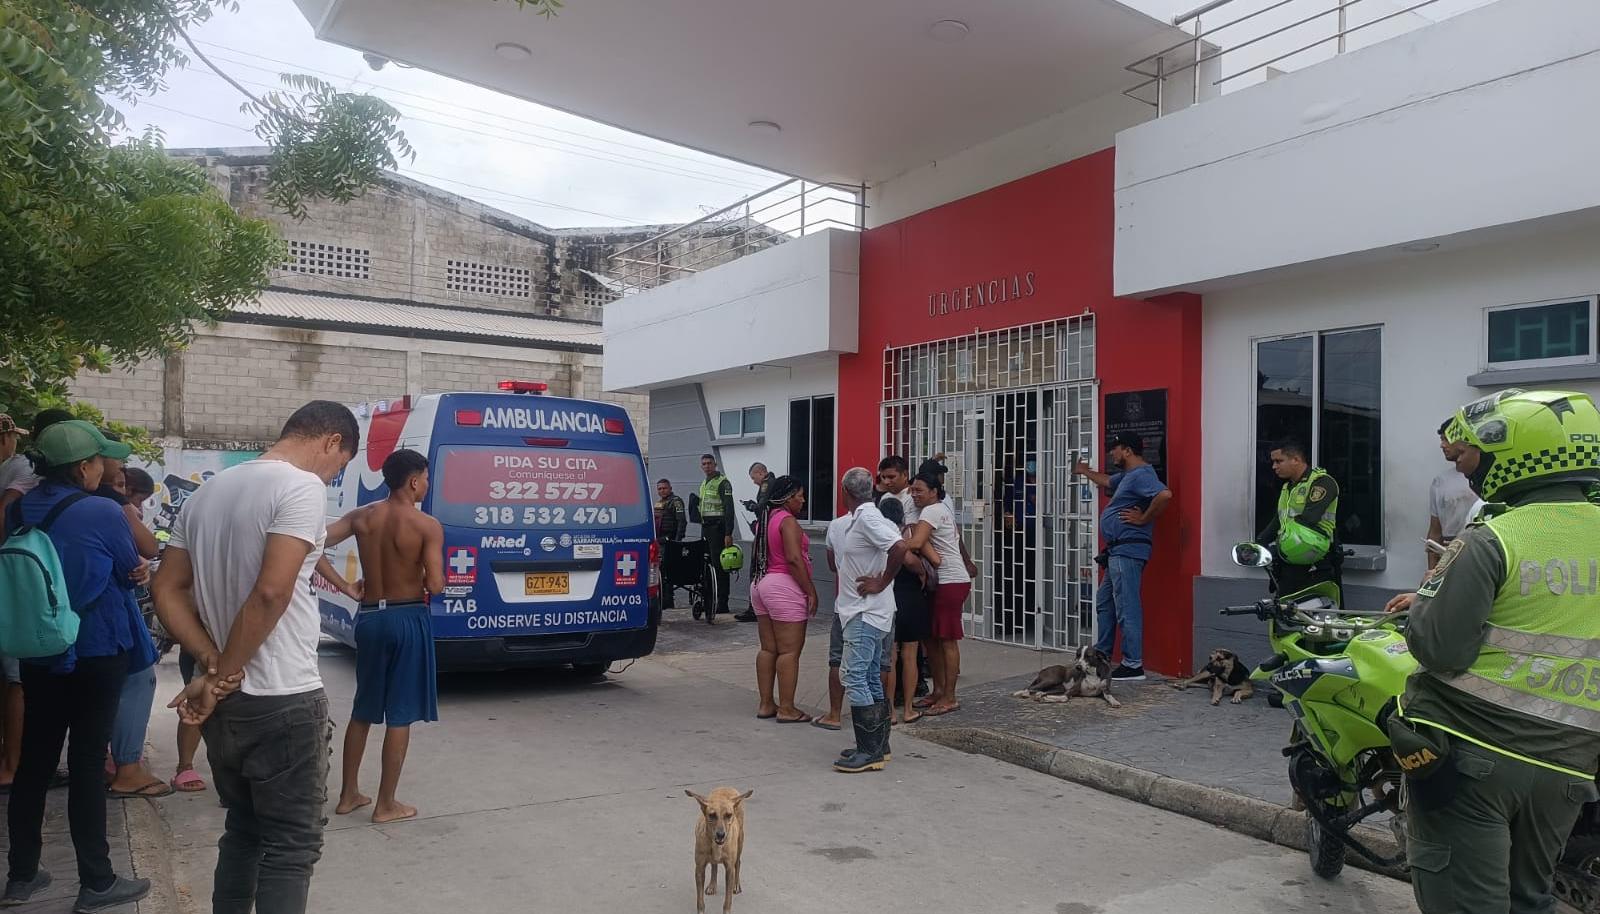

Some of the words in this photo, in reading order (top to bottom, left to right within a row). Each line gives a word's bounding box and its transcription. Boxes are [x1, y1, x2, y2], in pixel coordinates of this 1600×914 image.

[928, 272, 1034, 317] URGENCIAS
[482, 407, 603, 434] AMBULANCIA
[494, 456, 533, 469] PIDA
[538, 457, 561, 469] SU
[565, 458, 597, 471] CITA
[489, 481, 539, 500] 322
[544, 483, 604, 500] 5757
[475, 507, 514, 525] 318
[523, 507, 566, 525] 532
[573, 507, 617, 525] 4761
[480, 534, 527, 549] MiRed
[526, 575, 569, 590] GZT-943
[1519, 559, 1600, 596] POLI
[443, 599, 478, 614] TAB
[601, 596, 628, 606] MOV
[628, 595, 642, 605] 03
[467, 613, 541, 630] CONSERVE
[544, 613, 561, 626] SU
[564, 609, 628, 626] DISTANCIA
